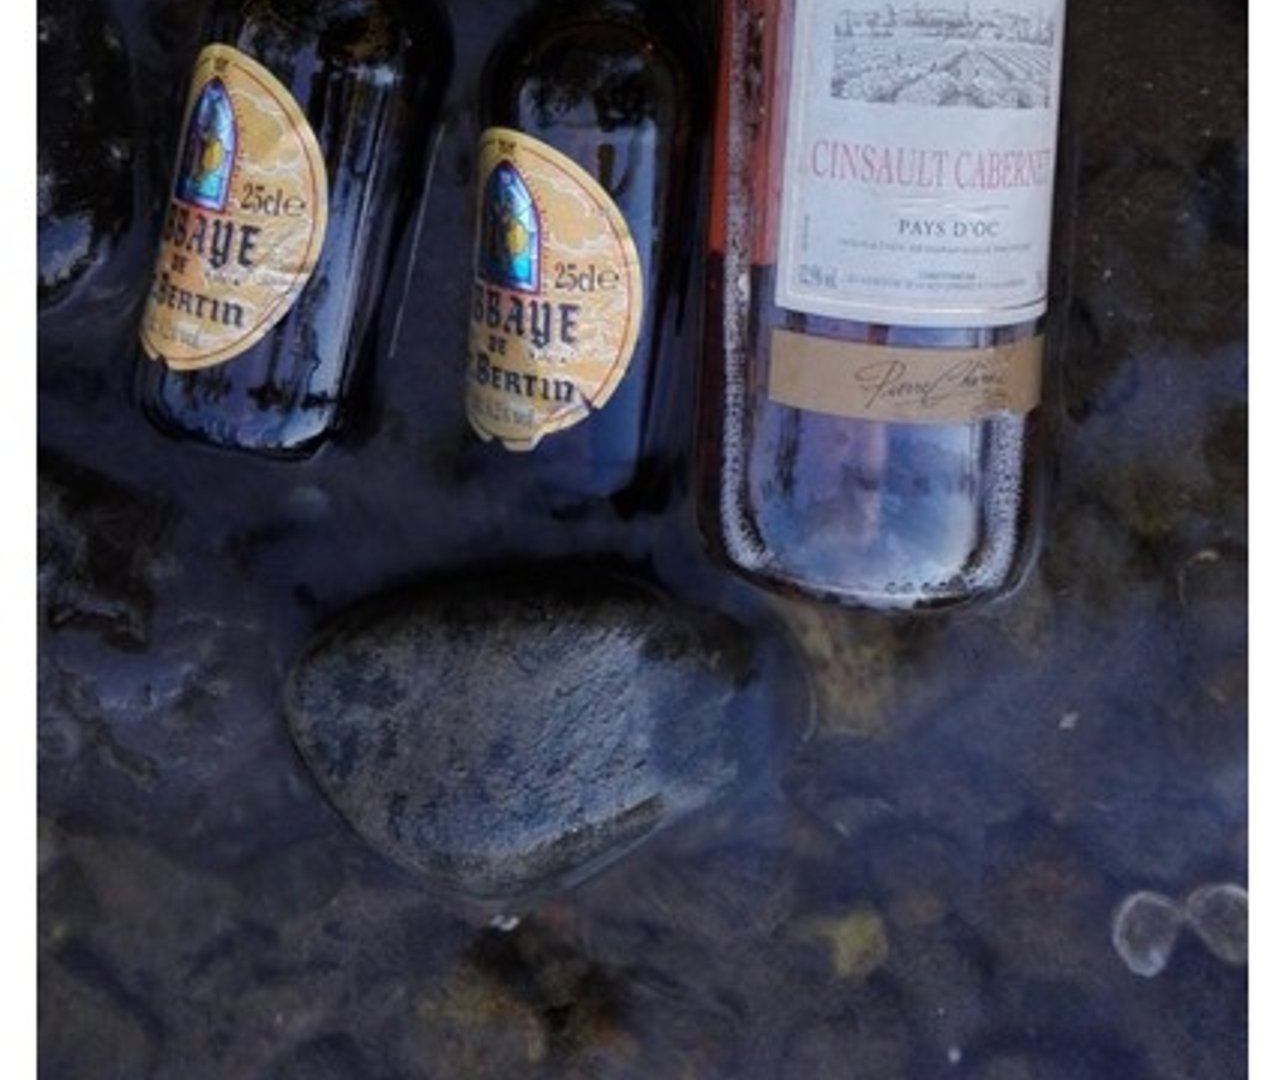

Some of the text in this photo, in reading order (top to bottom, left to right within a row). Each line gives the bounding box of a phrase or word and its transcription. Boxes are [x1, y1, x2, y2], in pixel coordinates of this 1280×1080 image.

[811, 139, 948, 189] CINSAULT
[898, 219, 1001, 238] PAYS D'OC
